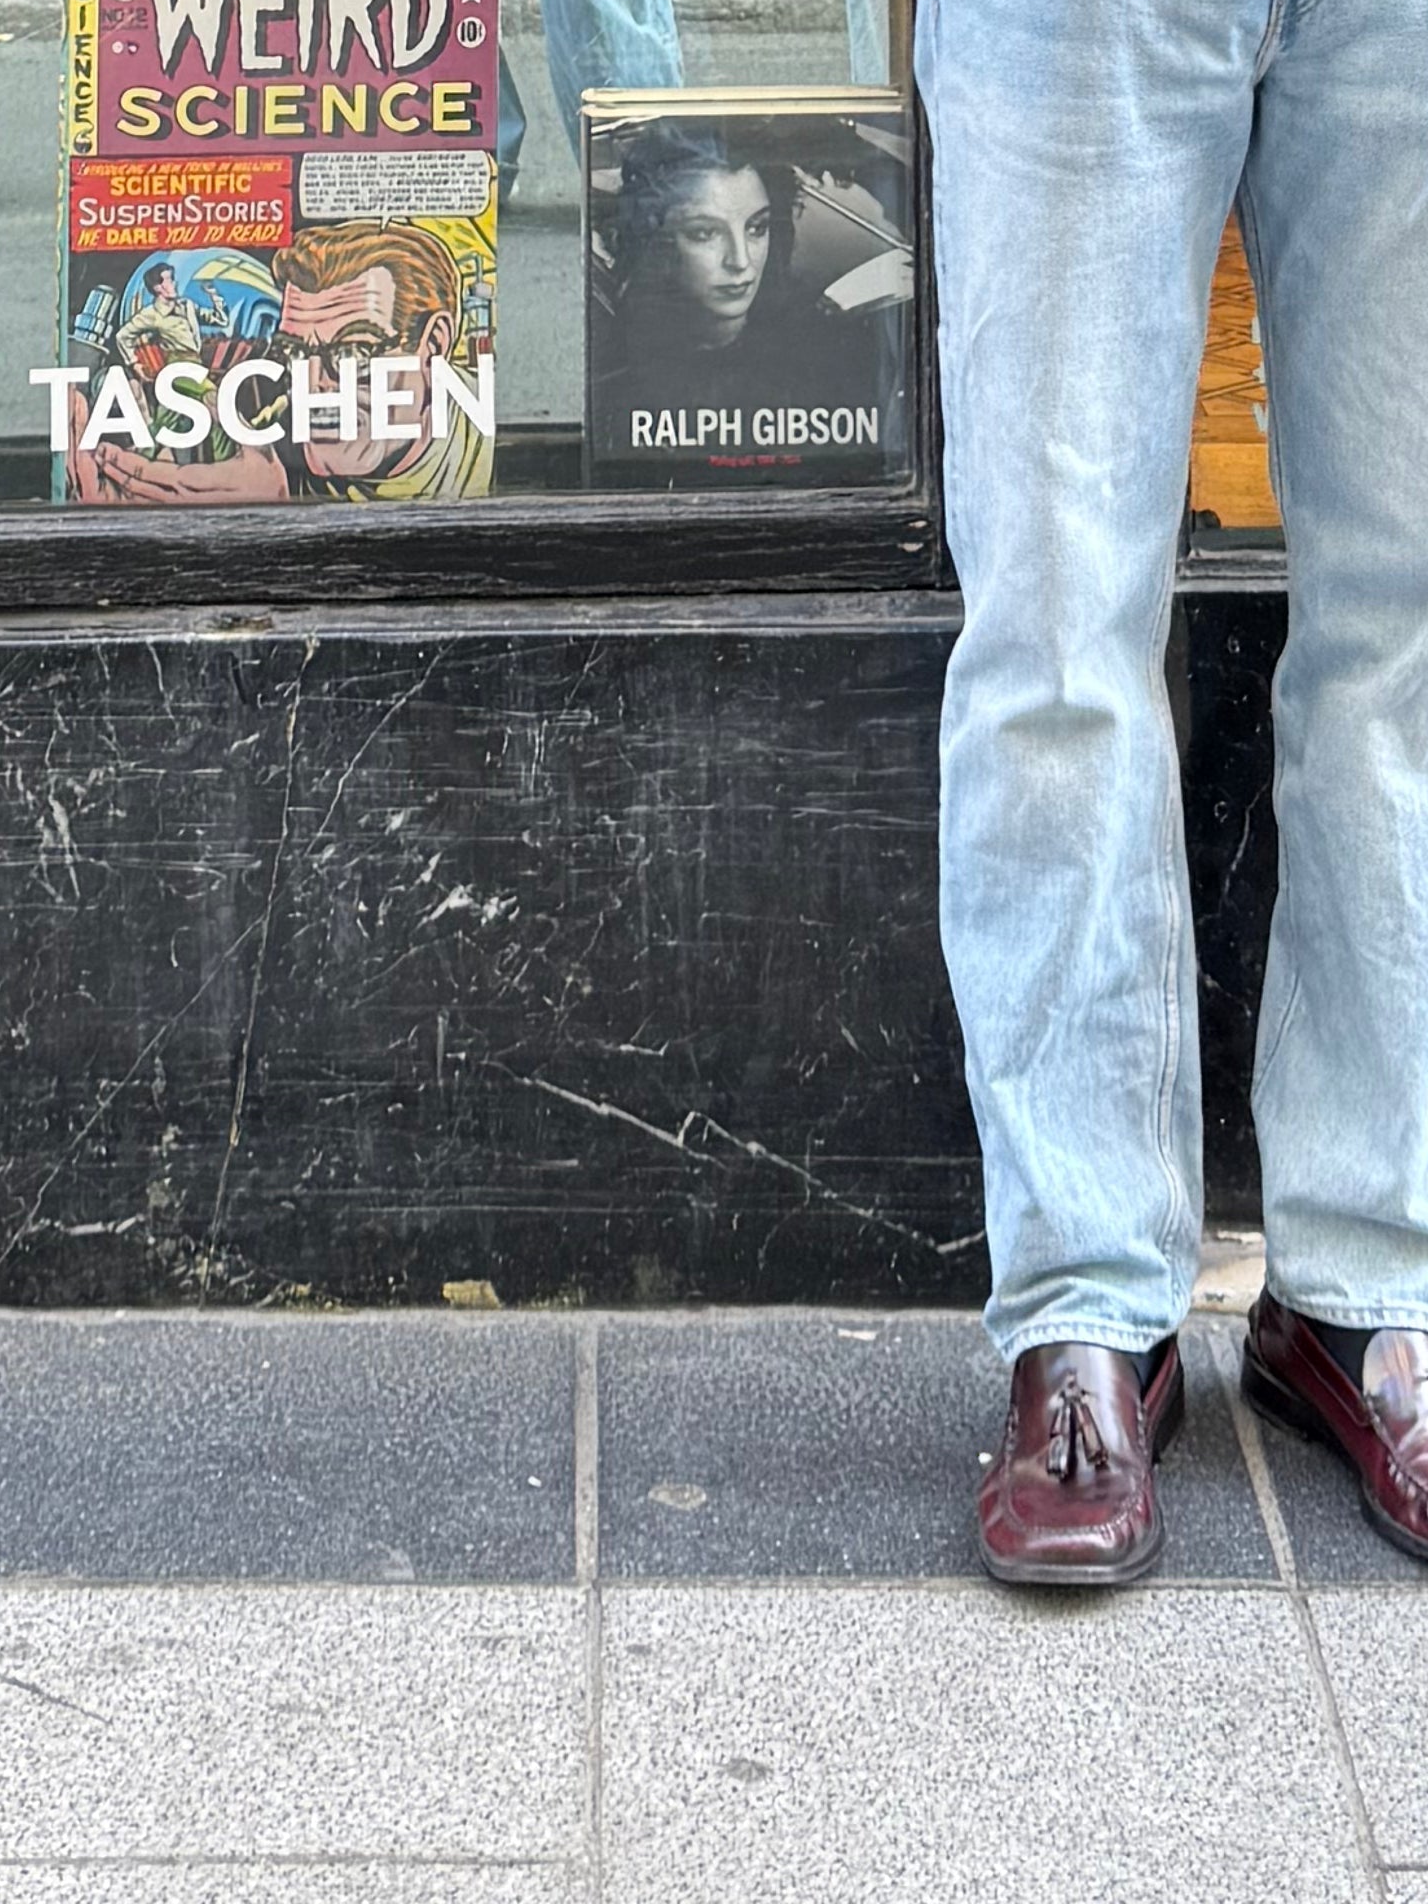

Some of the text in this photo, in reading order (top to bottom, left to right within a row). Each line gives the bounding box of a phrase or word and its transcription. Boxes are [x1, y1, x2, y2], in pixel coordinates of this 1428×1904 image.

[116, 81, 478, 139] SCIENCE
[109, 173, 253, 197] SCIENTIFIC
[78, 223, 283, 247] WE DARE YOU TO READ!
[29, 353, 496, 453] TASCHEN
[631, 406, 879, 448] RALPH GIBSON
